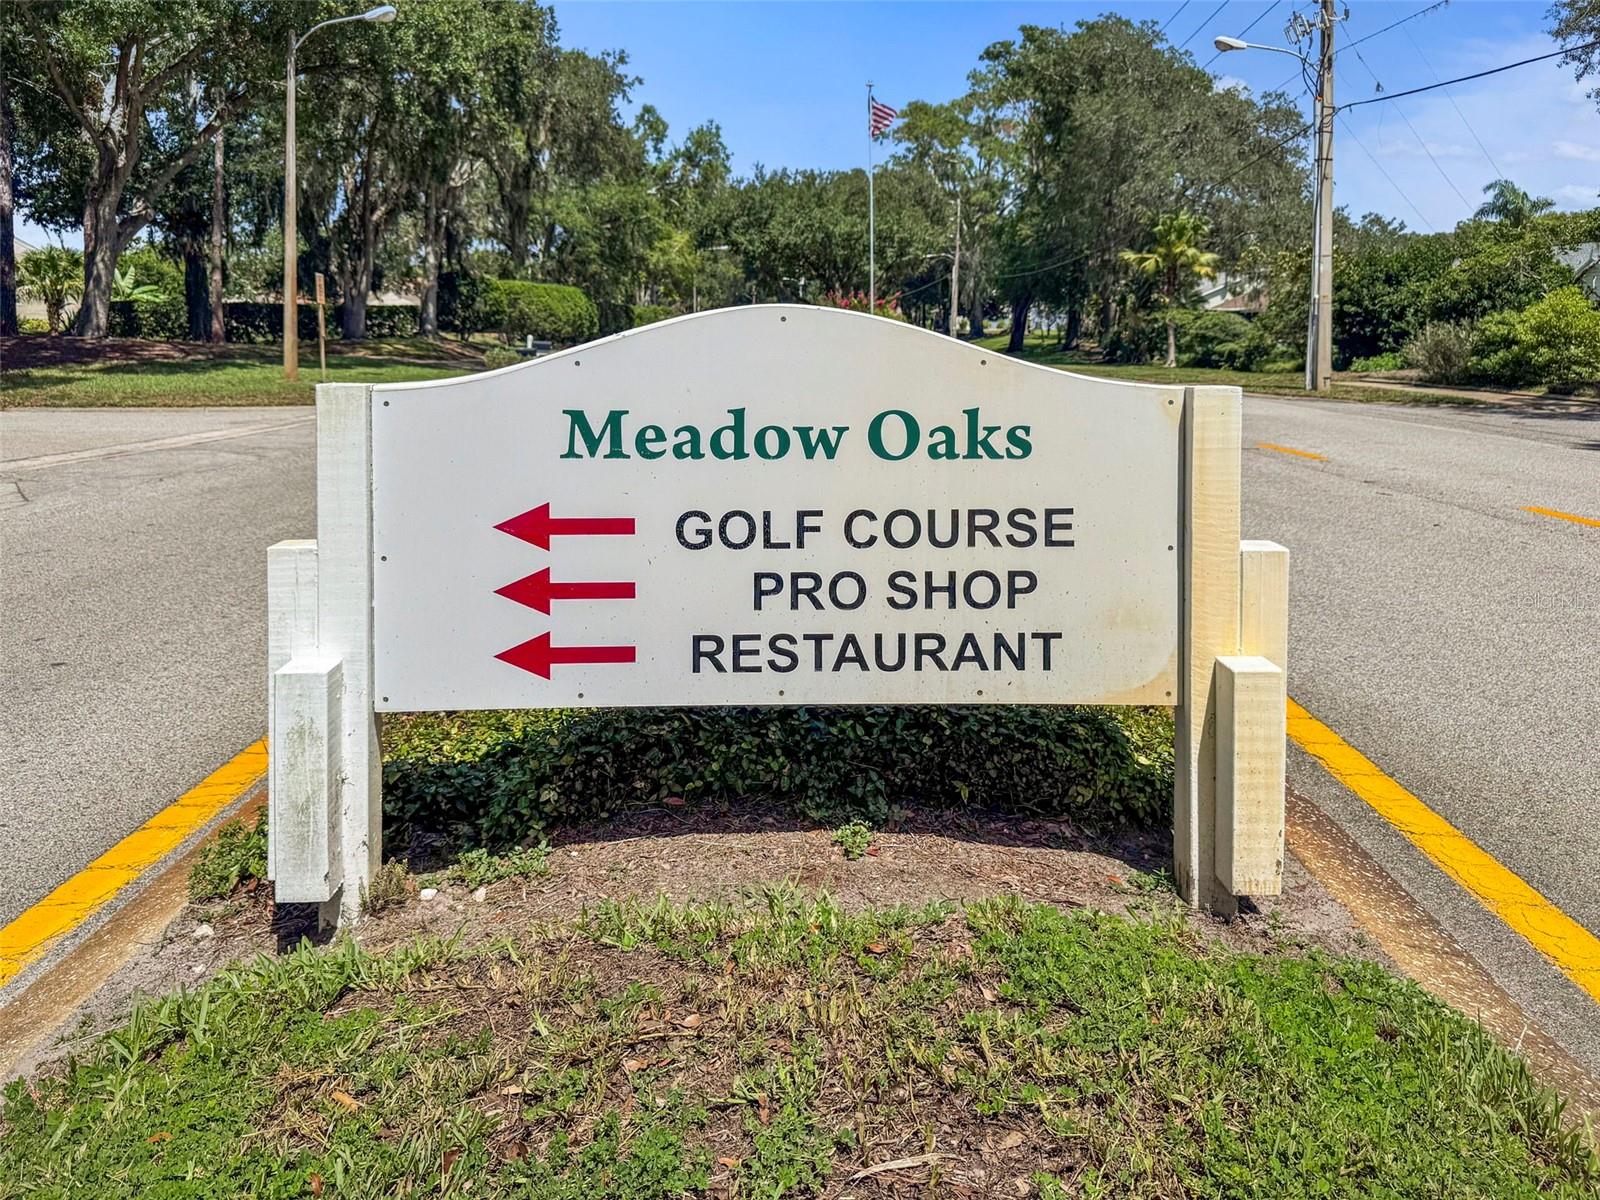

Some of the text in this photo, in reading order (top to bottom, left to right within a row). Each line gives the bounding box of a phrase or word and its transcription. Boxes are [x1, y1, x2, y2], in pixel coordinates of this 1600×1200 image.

[560, 407, 1033, 460] Meadow Oaks
[676, 508, 1075, 550] GOLF COURSE
[754, 570, 1037, 611] PRO SHOP
[693, 631, 1062, 673] RESTAURANT
